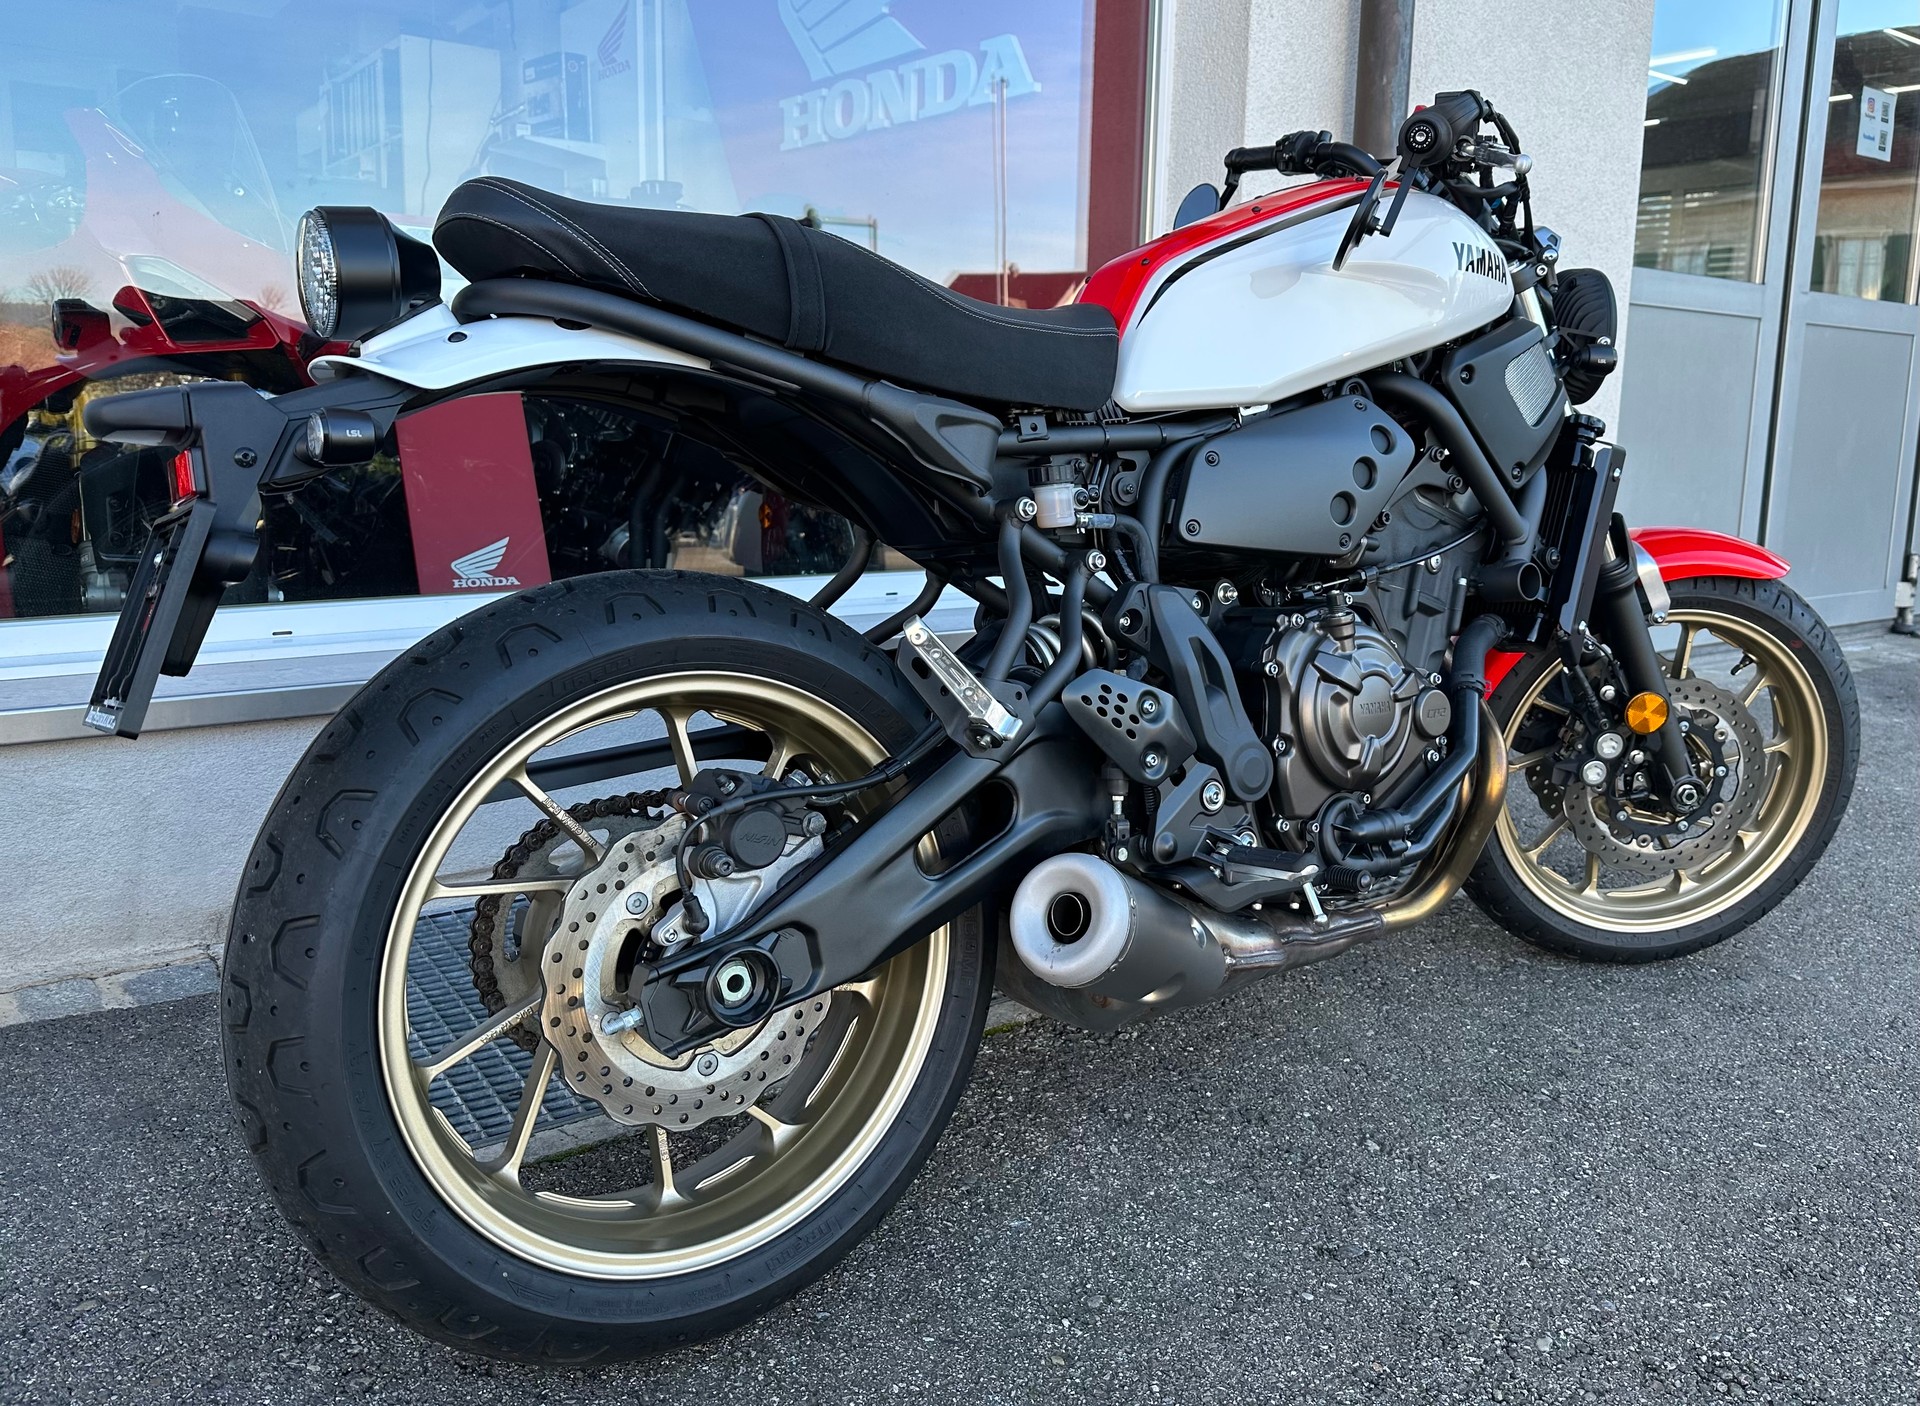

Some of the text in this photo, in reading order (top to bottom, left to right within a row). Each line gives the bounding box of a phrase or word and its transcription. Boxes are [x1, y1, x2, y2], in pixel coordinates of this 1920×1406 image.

[779, 33, 1042, 151] HONDA
[1452, 241, 1507, 285] YAMAHA
[346, 429, 363, 438] LSL
[452, 576, 521, 588] HONDA
[1360, 701, 1391, 715] YAMAHA
[1427, 707, 1447, 719] CP2
